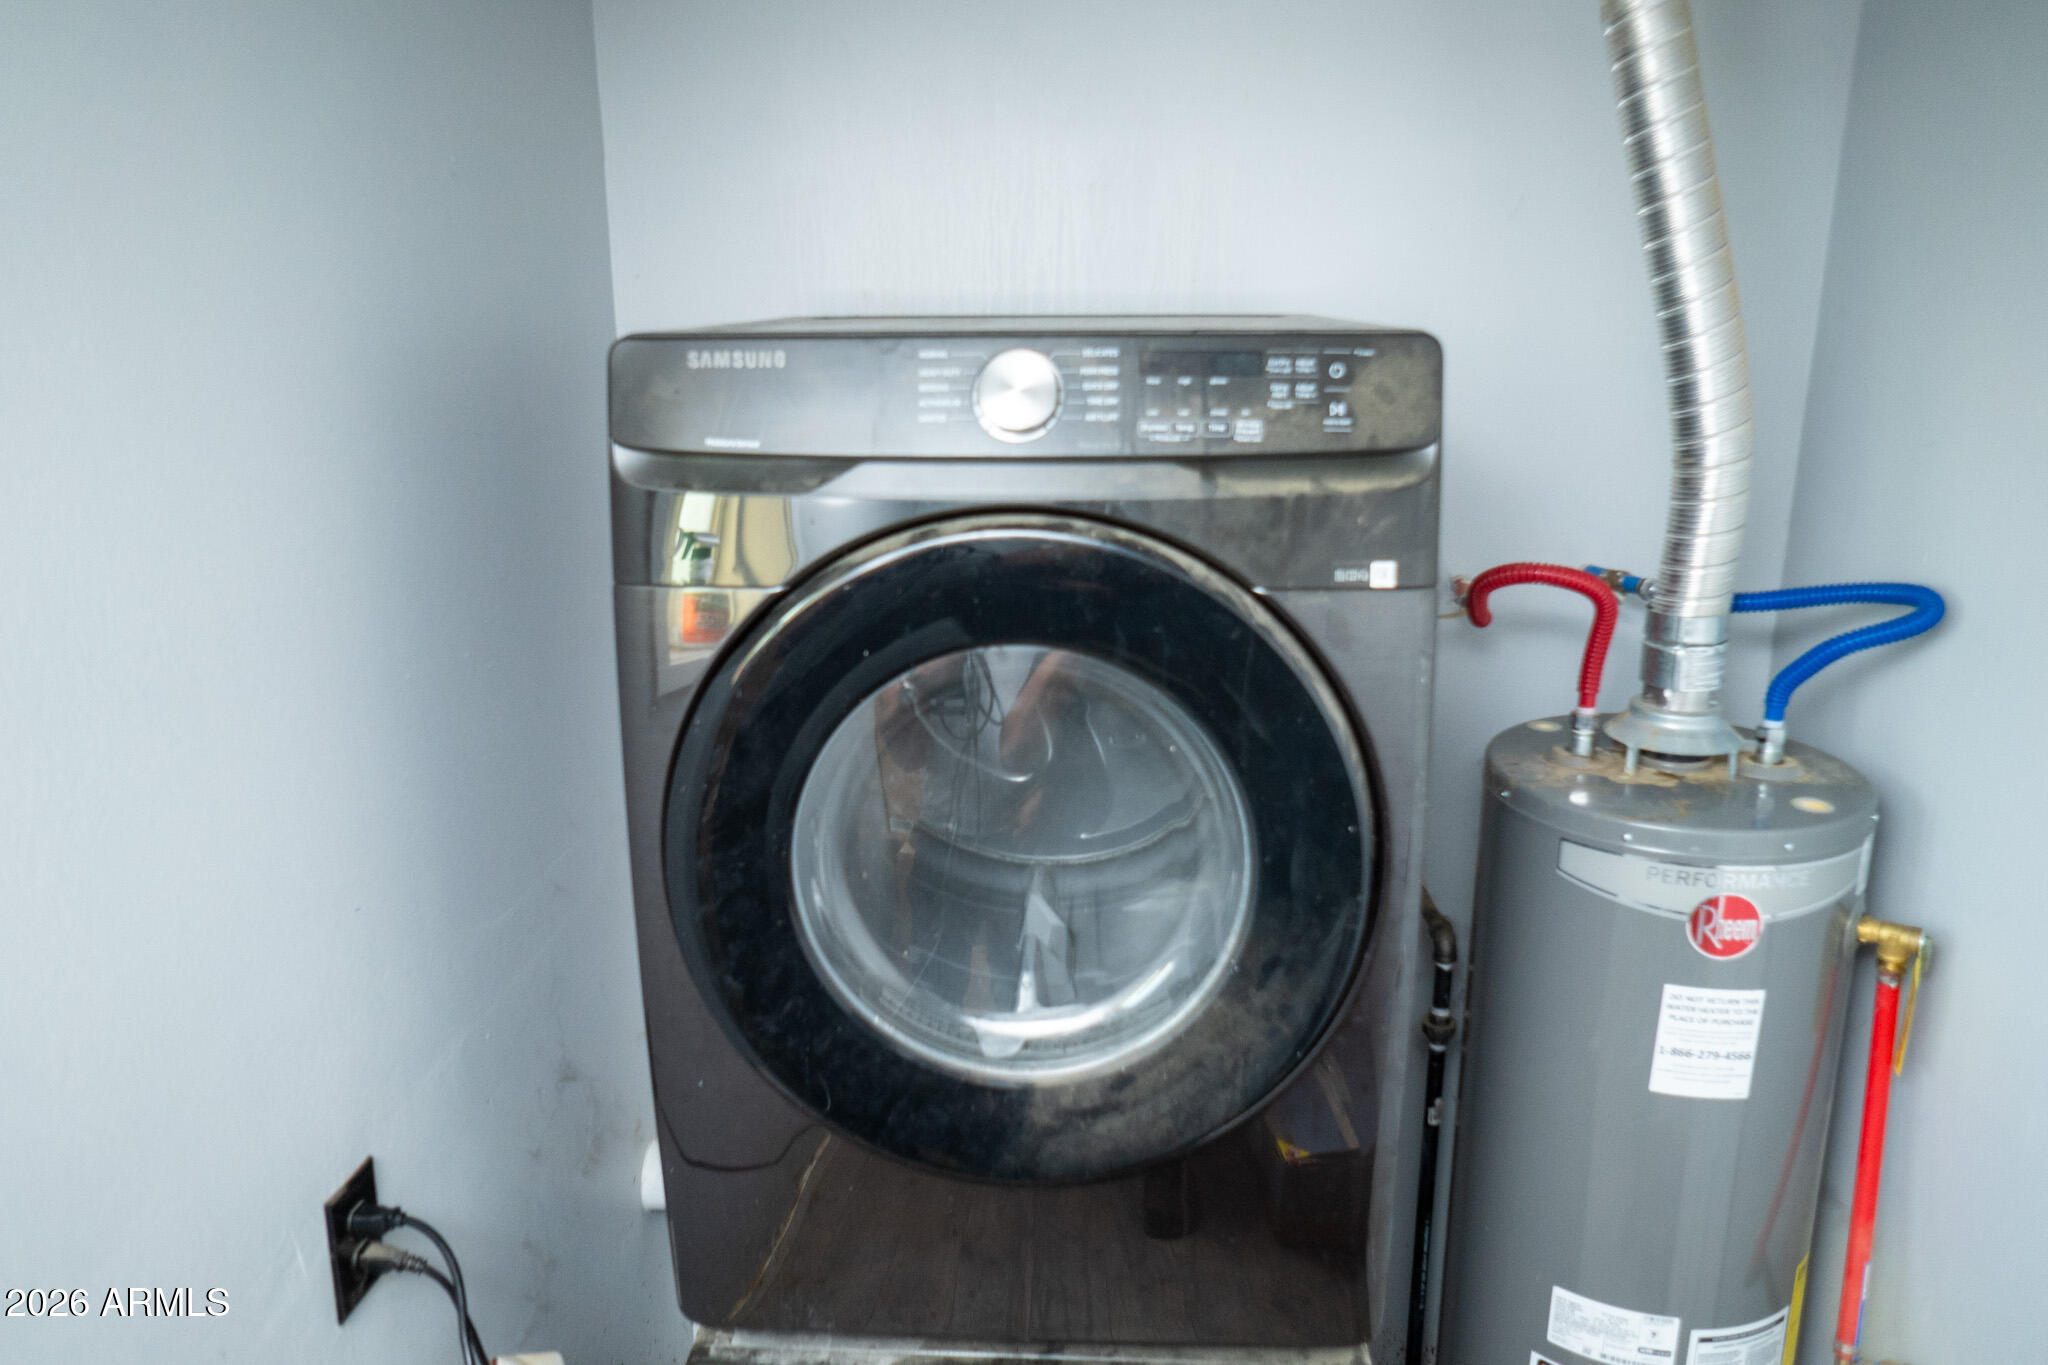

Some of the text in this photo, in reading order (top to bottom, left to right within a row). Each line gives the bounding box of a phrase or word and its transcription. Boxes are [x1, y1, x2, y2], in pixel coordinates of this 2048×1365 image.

[687, 349, 787, 369] SAMSUNG
[1646, 866, 1810, 890] PERFORMANCE
[1697, 895, 1757, 949] Rheem
